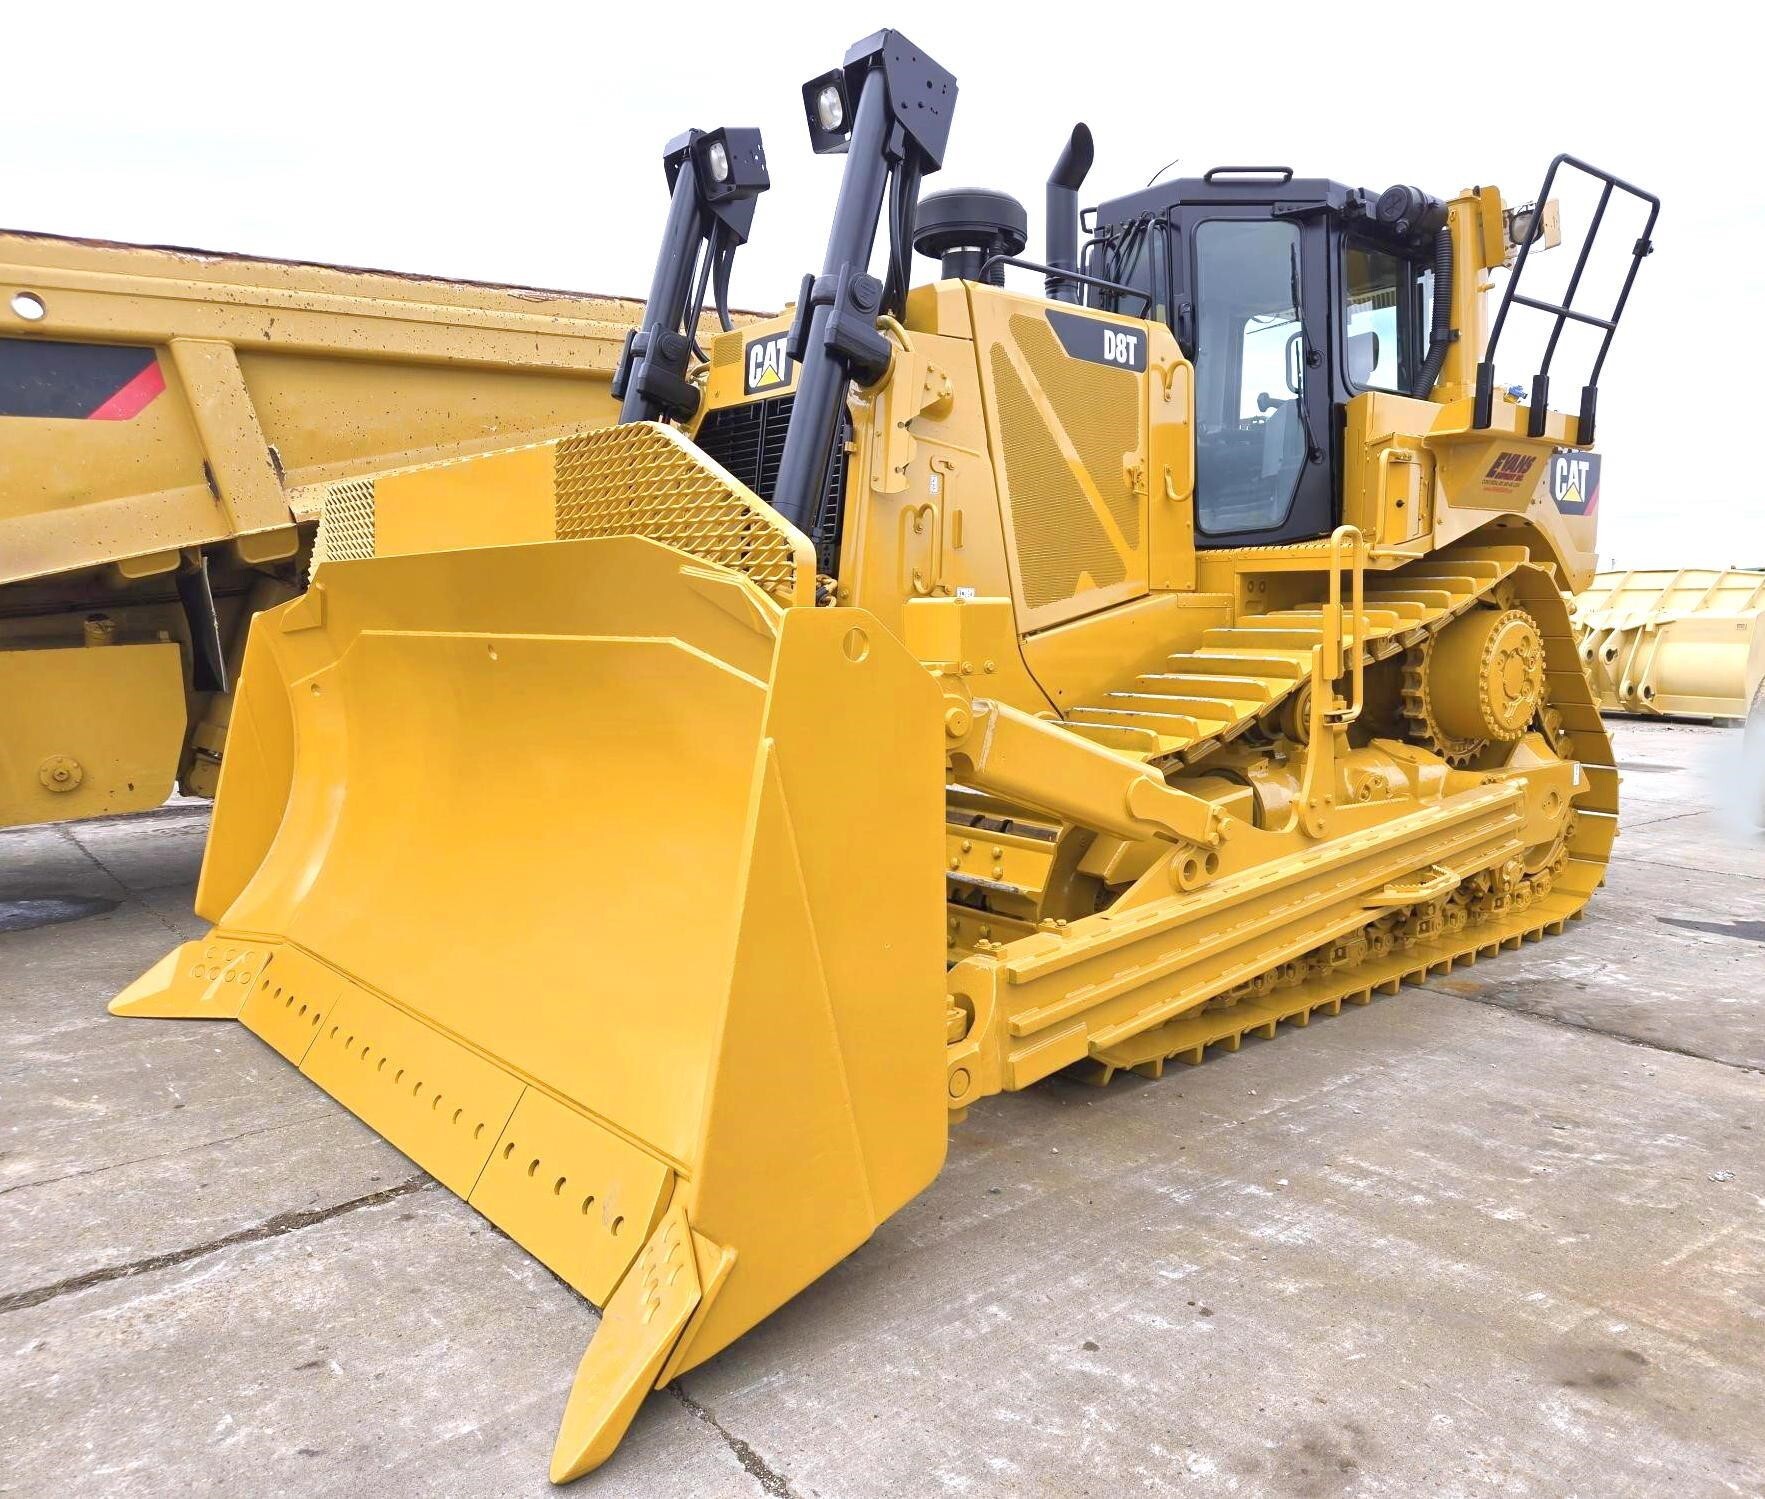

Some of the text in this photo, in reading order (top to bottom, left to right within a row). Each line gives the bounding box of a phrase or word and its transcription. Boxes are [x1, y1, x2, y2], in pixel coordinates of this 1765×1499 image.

[748, 337, 788, 389] CAT
[1103, 329, 1138, 365] D8T
[1487, 451, 1537, 478] EVANS
[1555, 457, 1590, 503] CAT
